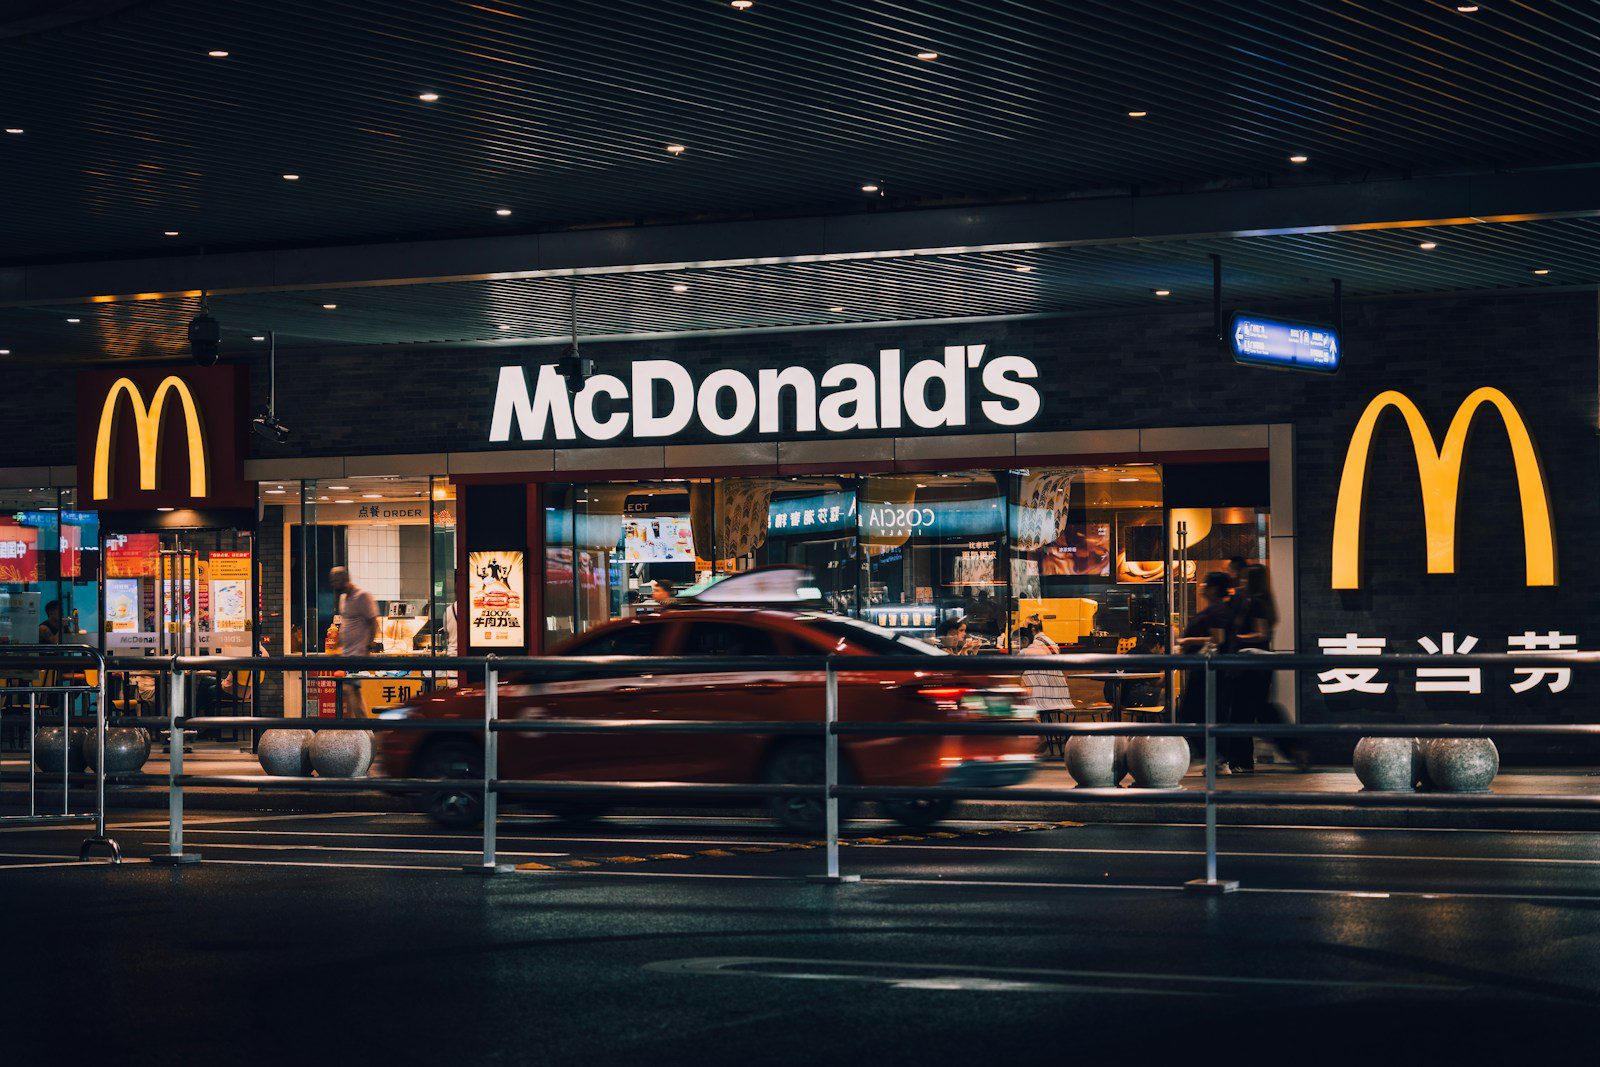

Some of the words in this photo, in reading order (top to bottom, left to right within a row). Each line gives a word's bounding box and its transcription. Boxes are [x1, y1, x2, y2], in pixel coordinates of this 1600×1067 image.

[489, 344, 1041, 443] McDonald's
[359, 505, 379, 518] 点餐
[384, 509, 422, 518] ORDER
[624, 503, 649, 512] ECT
[473, 617, 520, 628] 牛肉力量
[120, 635, 156, 643] McDonal
[1317, 631, 1578, 694] 麦当劳
[382, 686, 423, 703] 手机
